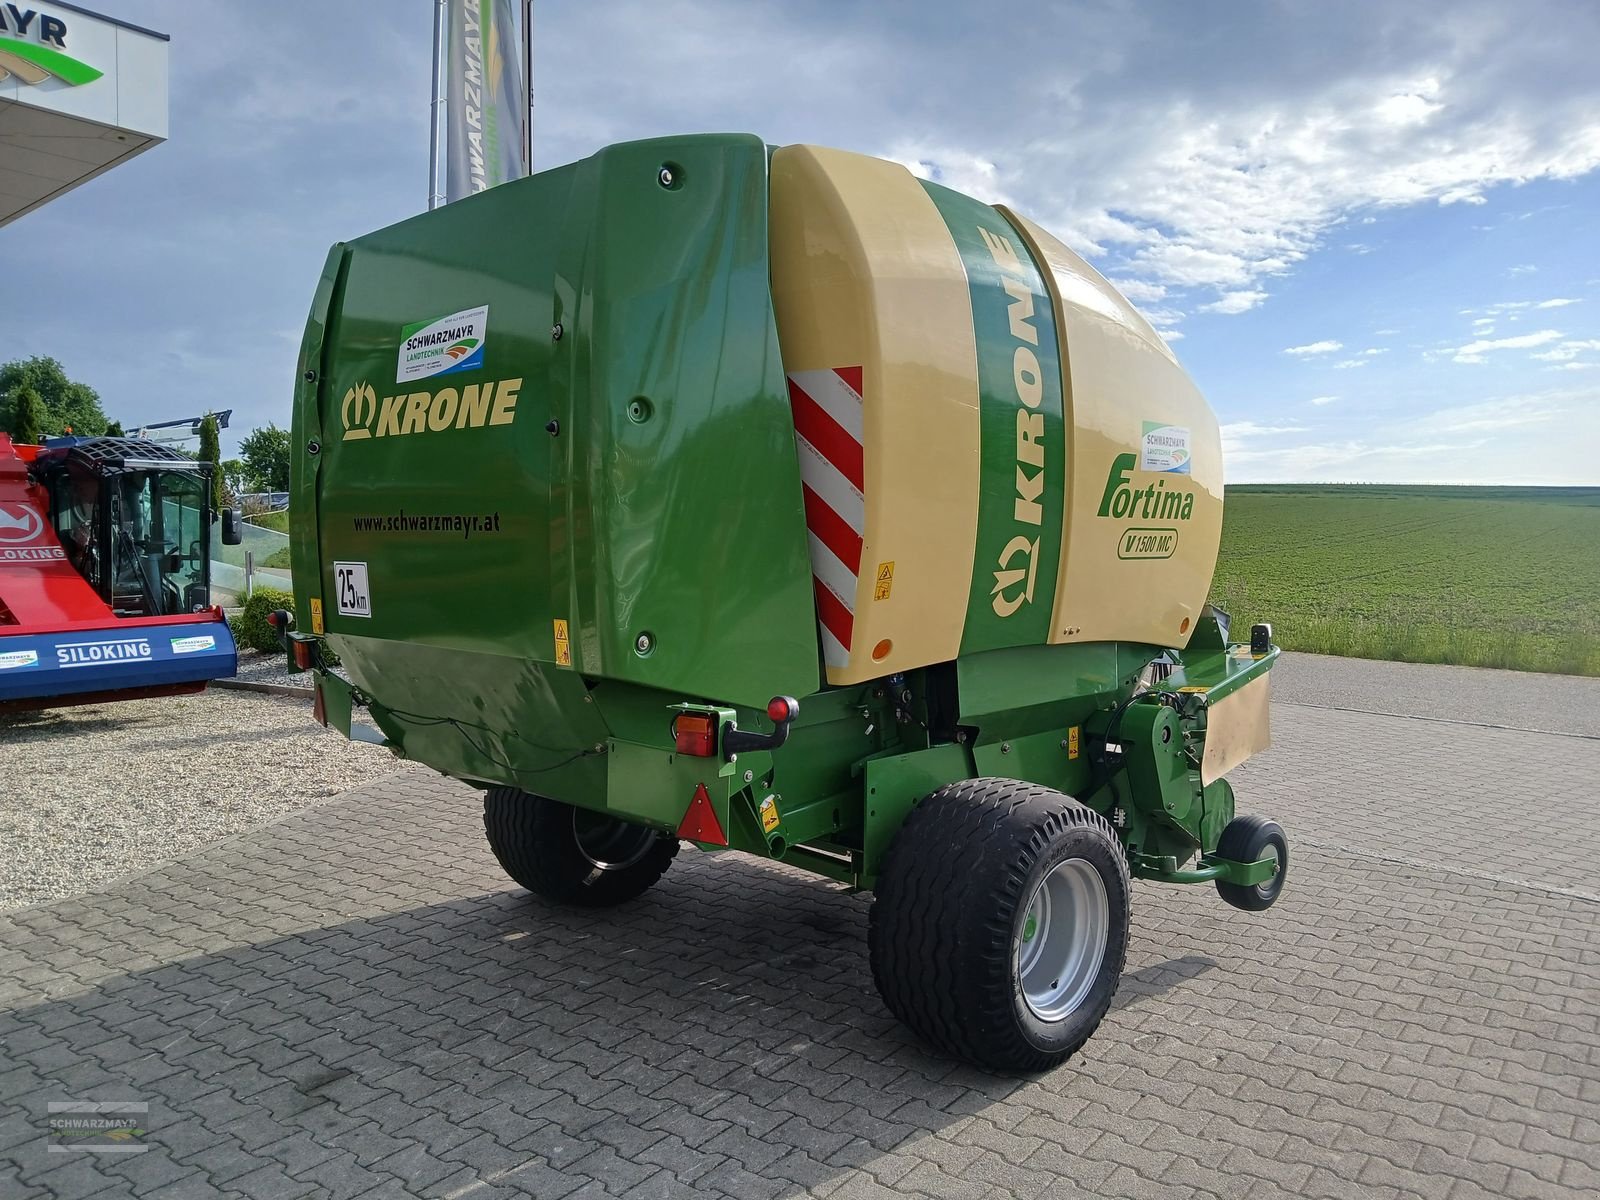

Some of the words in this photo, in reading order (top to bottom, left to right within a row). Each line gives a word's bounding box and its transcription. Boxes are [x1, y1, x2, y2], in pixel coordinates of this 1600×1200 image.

[406, 325, 474, 351] SCHWARZMAYR
[406, 347, 445, 362] LANDTECHNIK
[977, 225, 1045, 526] KRONE
[376, 378, 523, 437] KRONE
[1097, 453, 1194, 520] Fortima
[354, 510, 500, 539] www.schwarzmayr.at
[1125, 535, 1137, 552] V
[1135, 535, 1157, 553] 1500
[1156, 535, 1173, 553] MC
[338, 568, 356, 609] 25
[355, 590, 367, 609] km
[57, 642, 151, 663] SILOKING
